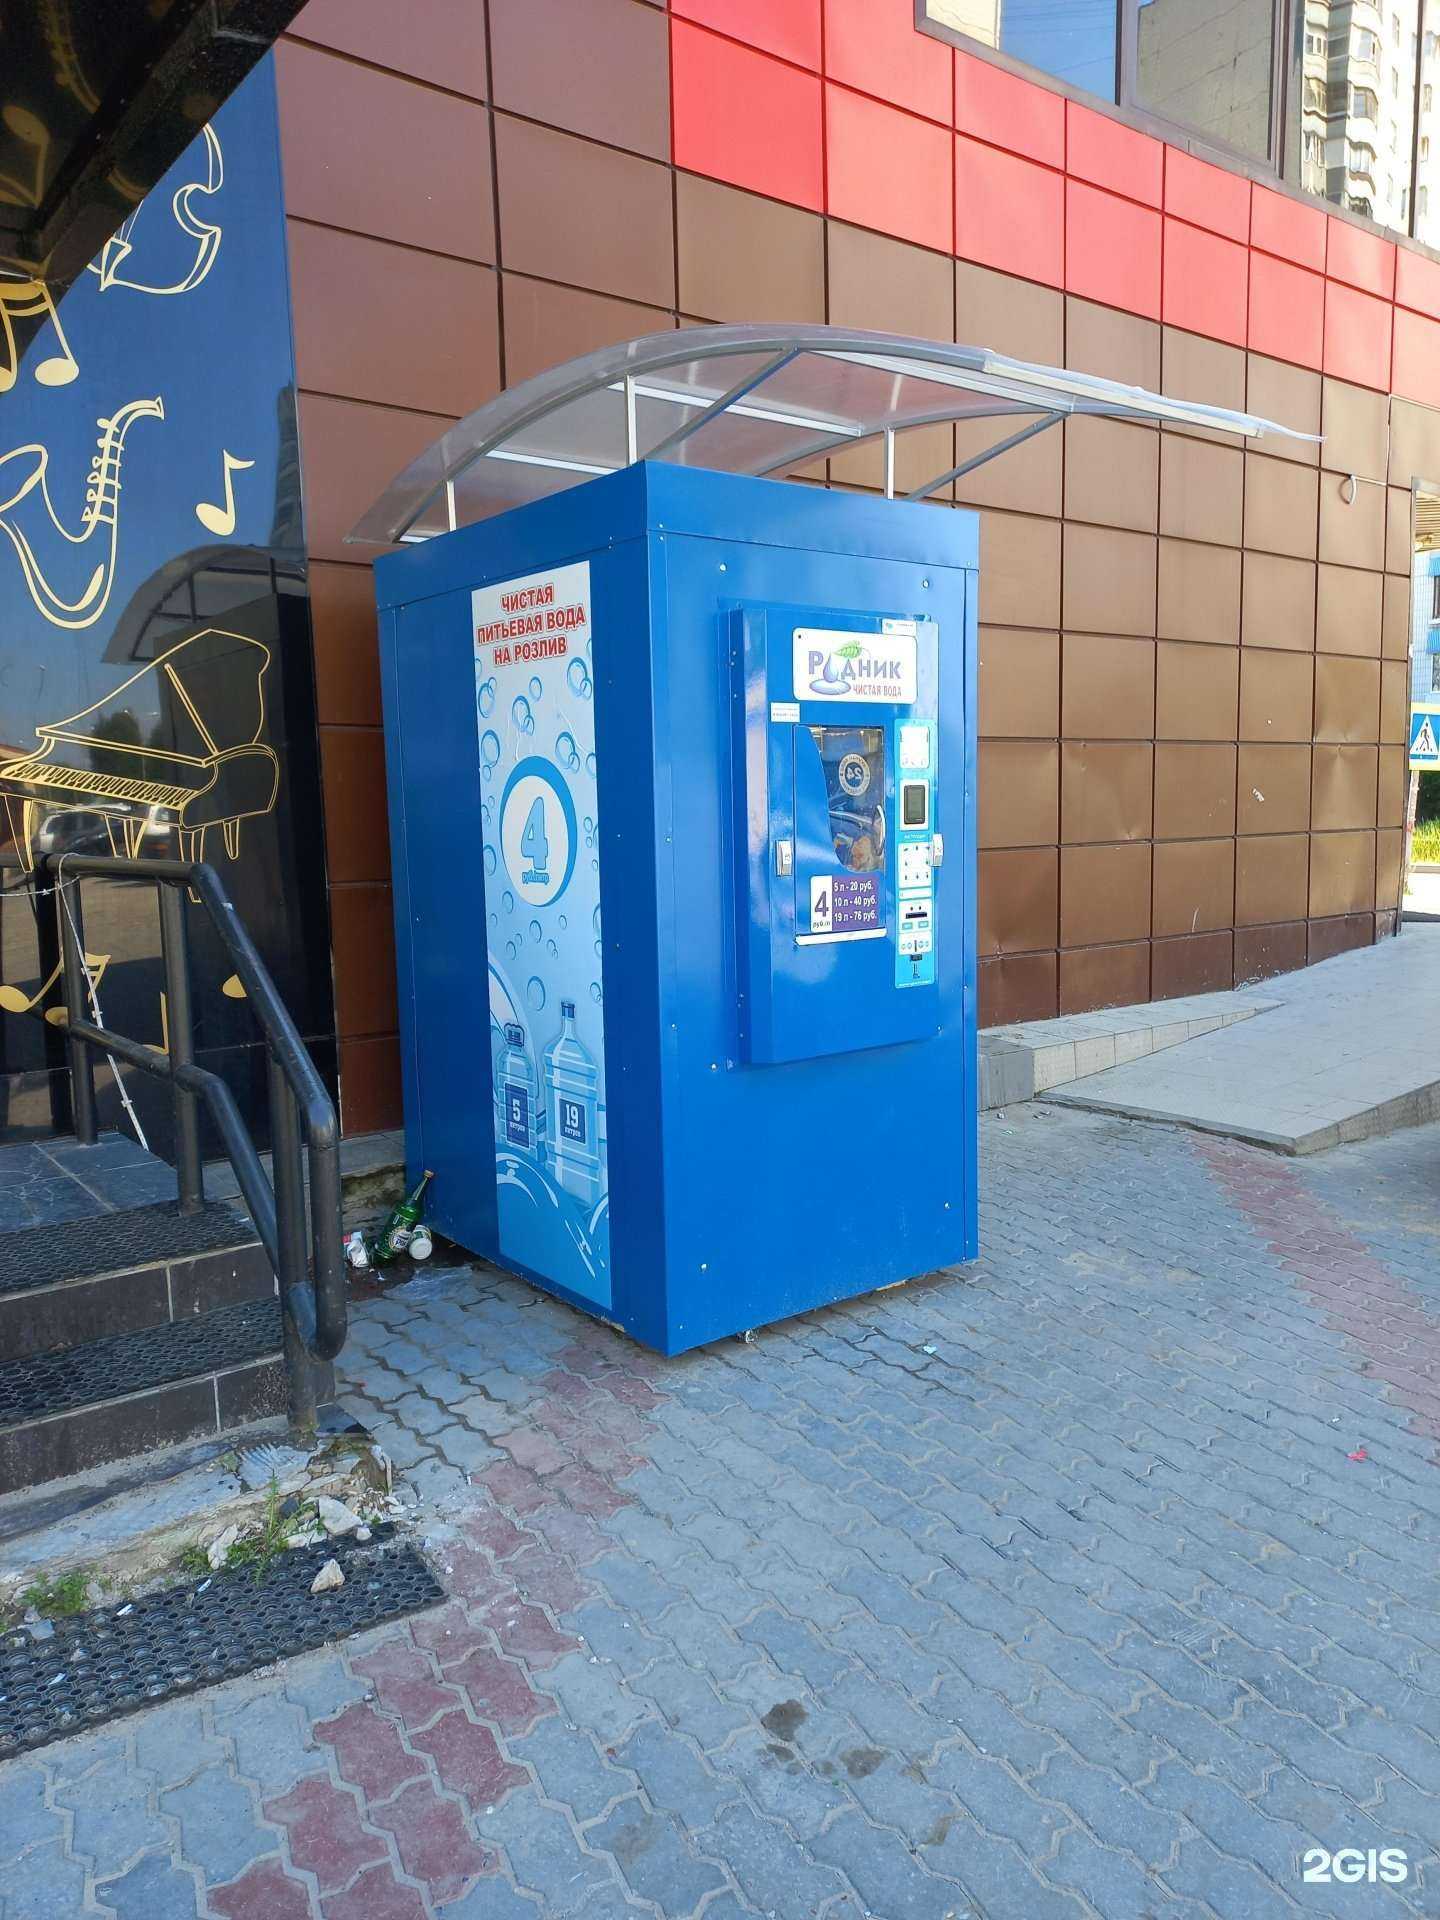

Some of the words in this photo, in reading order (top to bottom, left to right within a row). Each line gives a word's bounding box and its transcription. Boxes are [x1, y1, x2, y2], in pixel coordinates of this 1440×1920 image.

[501, 584, 554, 613] ЧИСТАЯ
[477, 613, 543, 644] ПИТЬЕВАЯ
[546, 605, 586, 631] ВОДА
[494, 647, 511, 666] НА
[514, 635, 567, 662] РОЗЛИВ
[853, 684, 881, 696] ЧИСТАЯ
[883, 685, 902, 697] ВОДА
[521, 797, 548, 870] 4
[834, 881, 839, 892] 5
[850, 880, 858, 891] 20
[859, 880, 874, 893] руб.
[815, 891, 829, 917] 4
[834, 897, 842, 907] 10
[853, 895, 861, 906] 40
[834, 912, 842, 922] 19
[853, 911, 861, 921] 76
[512, 1099, 521, 1121] 5
[566, 1104, 579, 1127] 19
